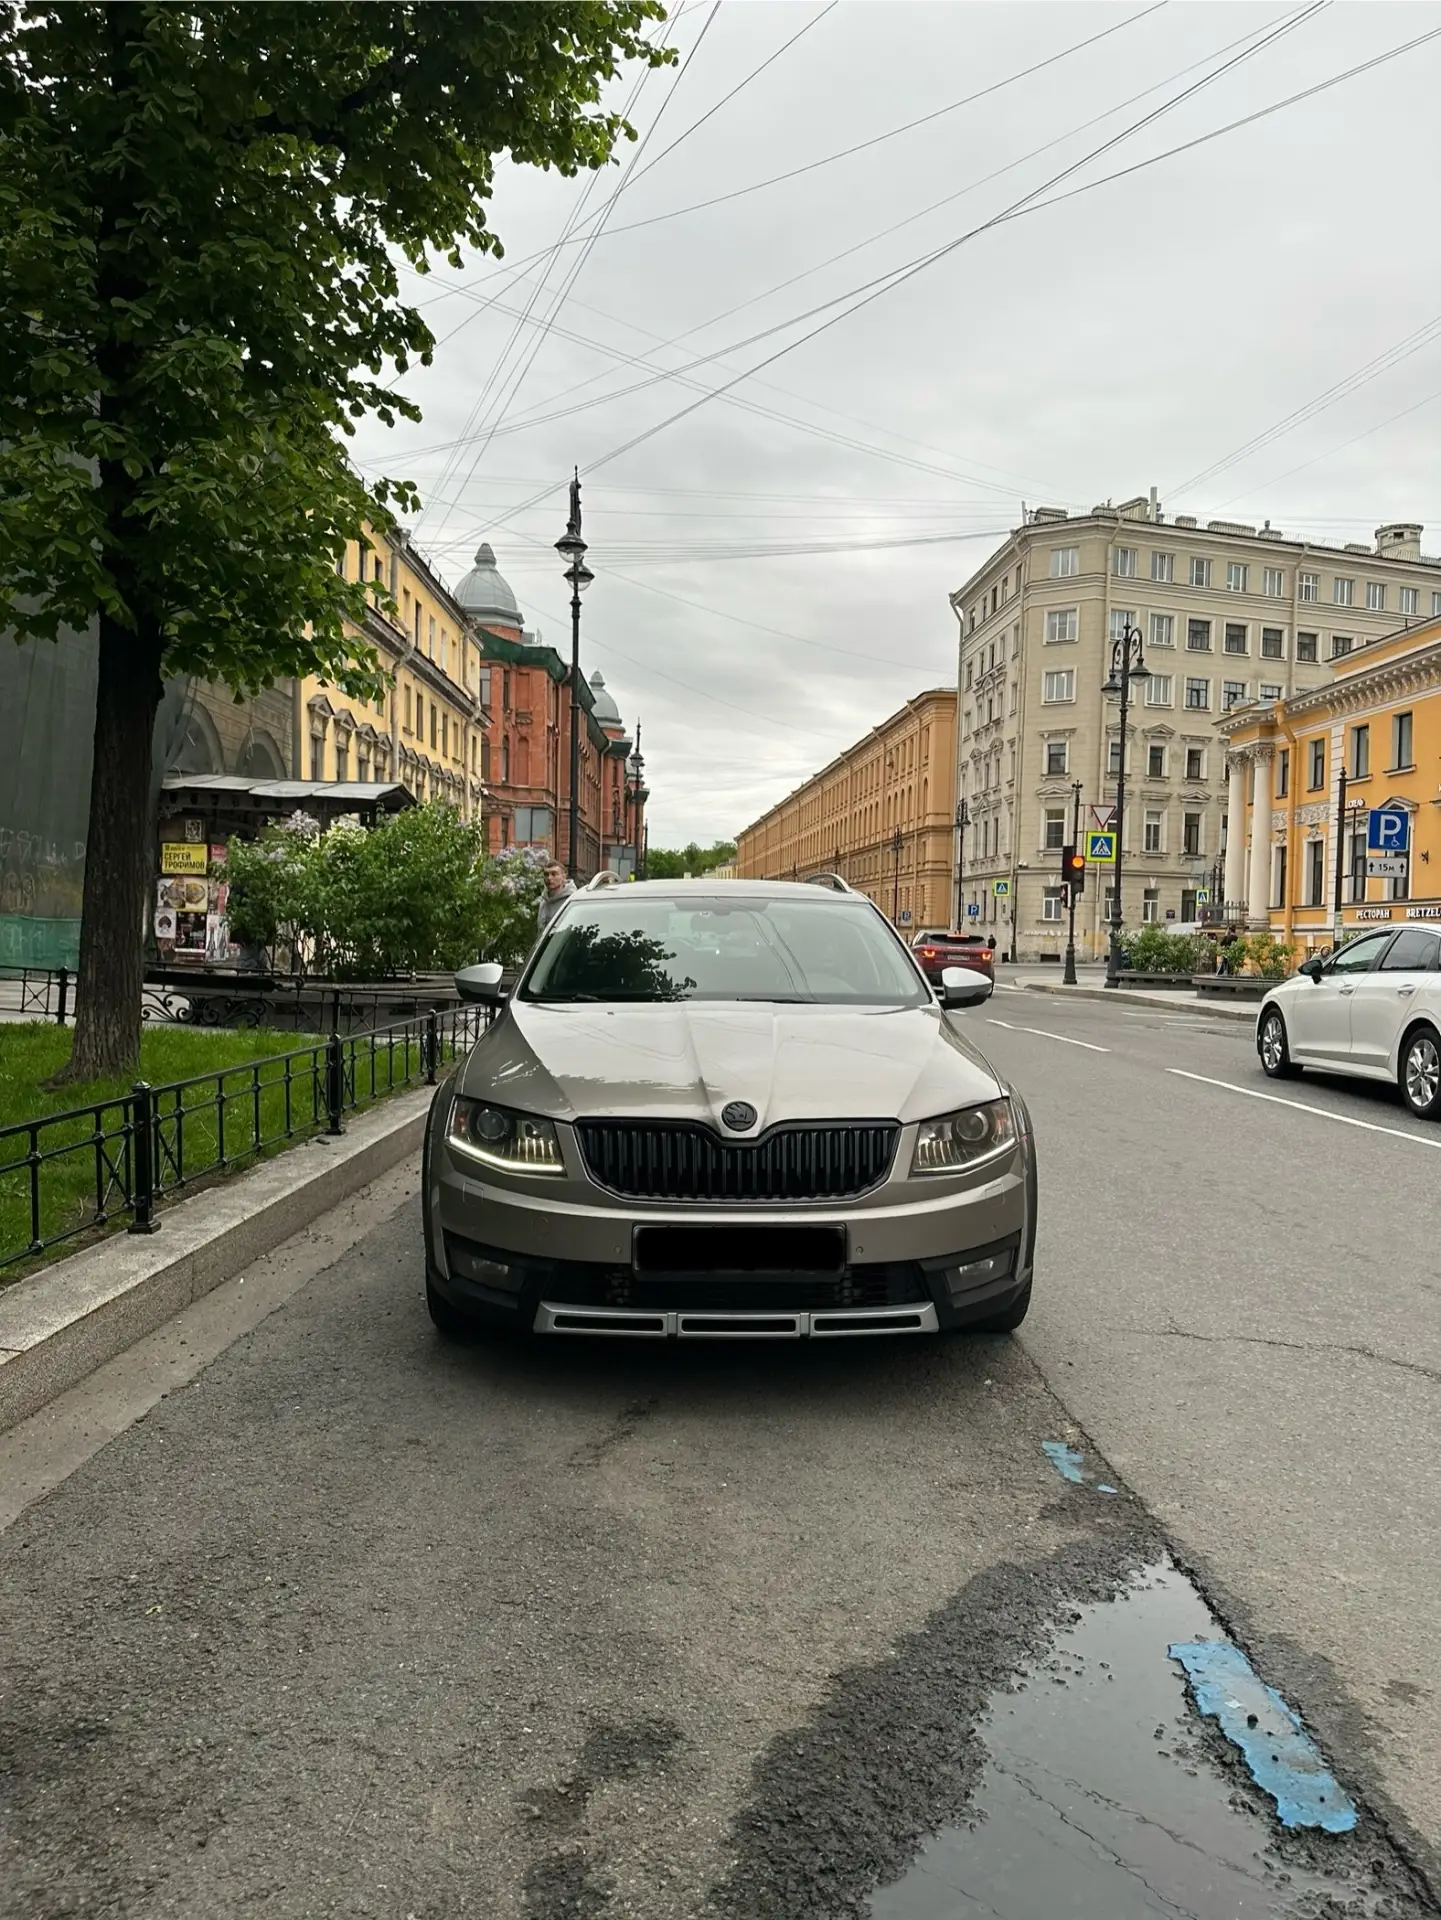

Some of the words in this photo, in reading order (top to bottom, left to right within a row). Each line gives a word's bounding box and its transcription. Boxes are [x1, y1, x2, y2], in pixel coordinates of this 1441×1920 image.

[1379, 814, 1402, 846] P
[164, 851, 191, 861] СЕРГЕЙ
[164, 861, 205, 870] ТРОФИМОВ
[1356, 908, 1391, 920] РЕСТОРАН
